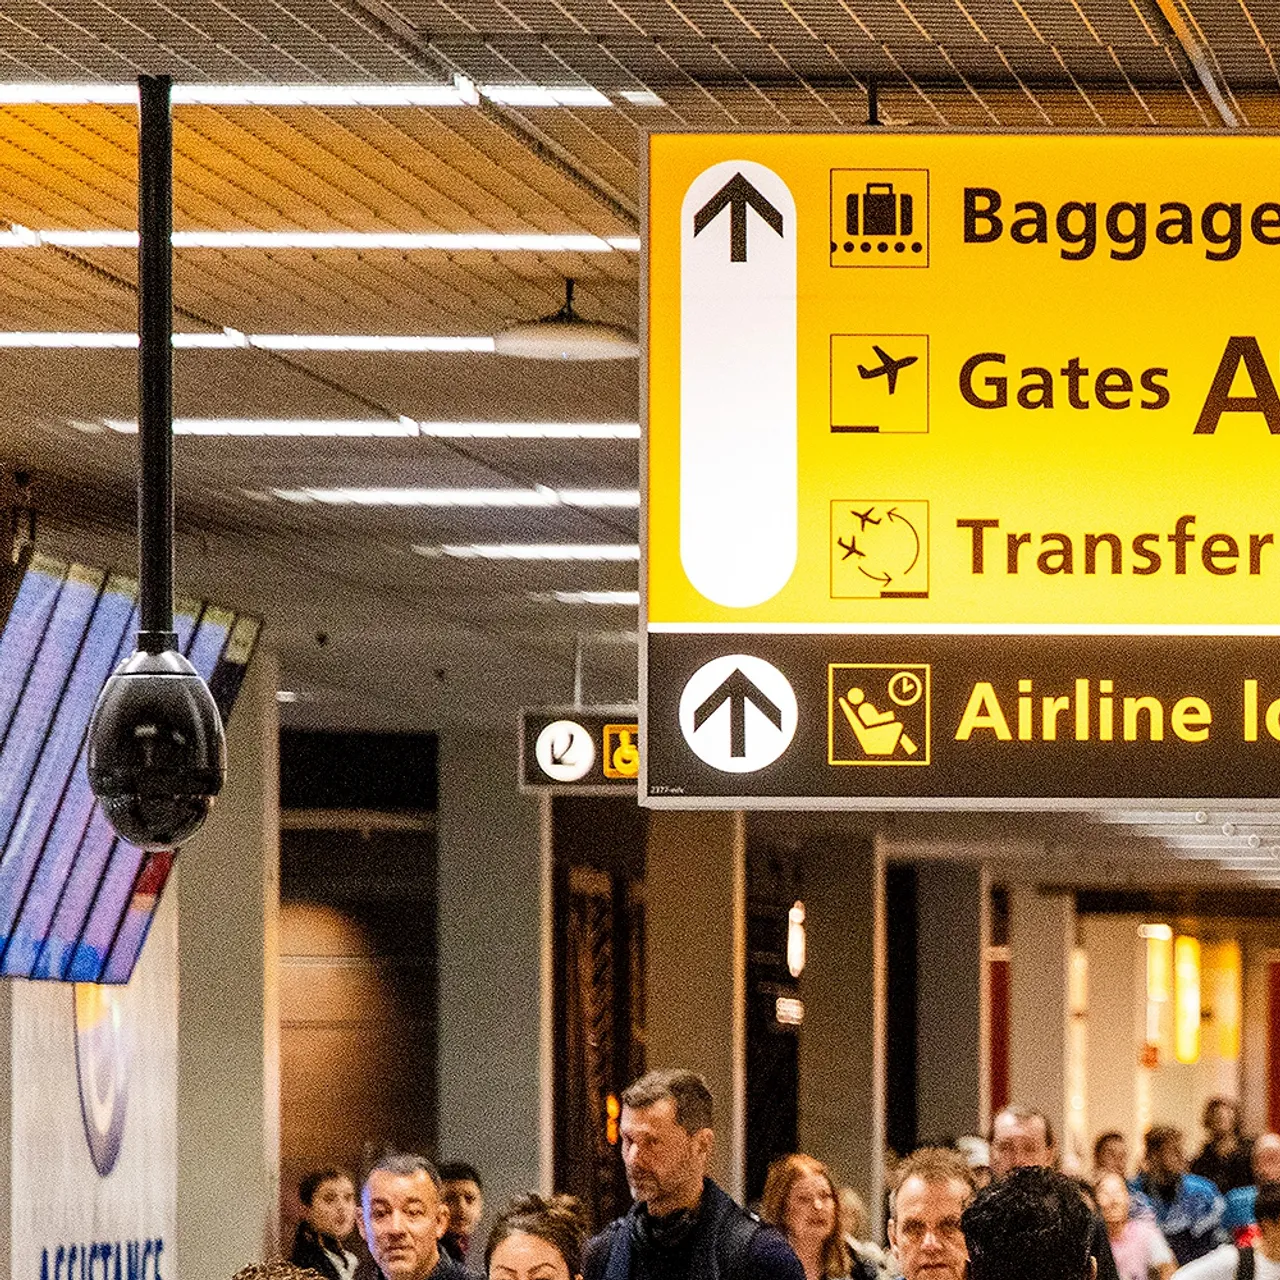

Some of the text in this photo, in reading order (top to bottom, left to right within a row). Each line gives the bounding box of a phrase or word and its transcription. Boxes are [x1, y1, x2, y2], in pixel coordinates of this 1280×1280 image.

[959, 352, 1170, 410] Gates
[957, 515, 1273, 575] Transfer
[956, 680, 1213, 743] Airline
